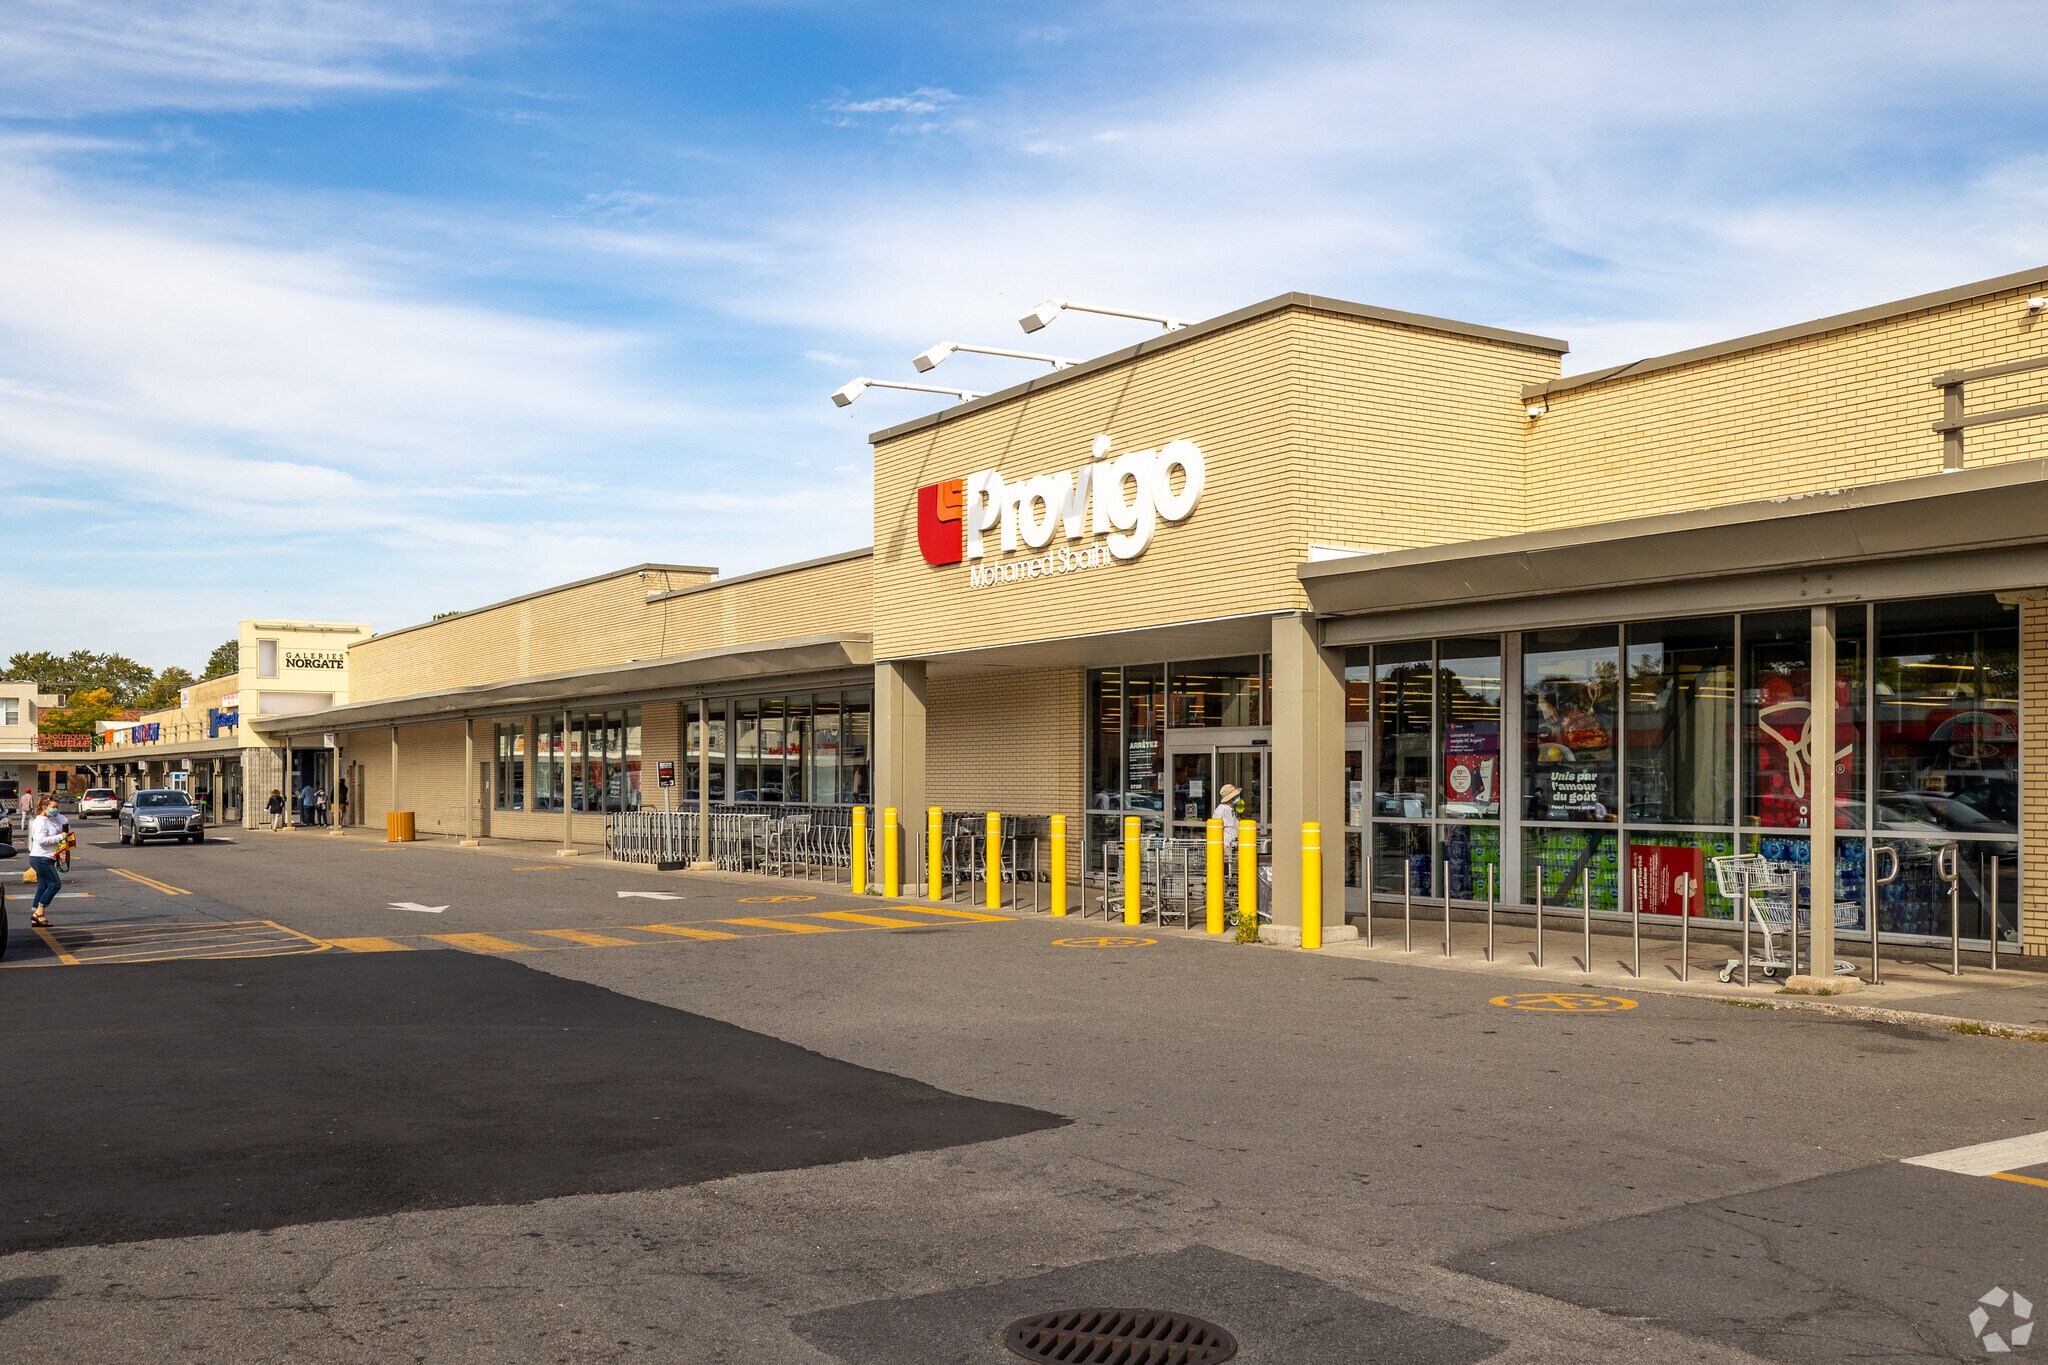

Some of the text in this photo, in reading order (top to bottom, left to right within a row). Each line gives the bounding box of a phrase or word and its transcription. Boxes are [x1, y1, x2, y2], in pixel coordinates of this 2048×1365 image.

[967, 434, 1205, 559] Provigo
[970, 549, 1054, 588] Mohamed
[286, 659, 344, 669] NORGATE
[54, 740, 91, 748] RUELLE
[1130, 740, 1158, 749] ARRÊTEZ
[1551, 772, 1597, 782] Unis par
[1552, 782, 1597, 790] l'amour
[1553, 791, 1597, 803] du goût
